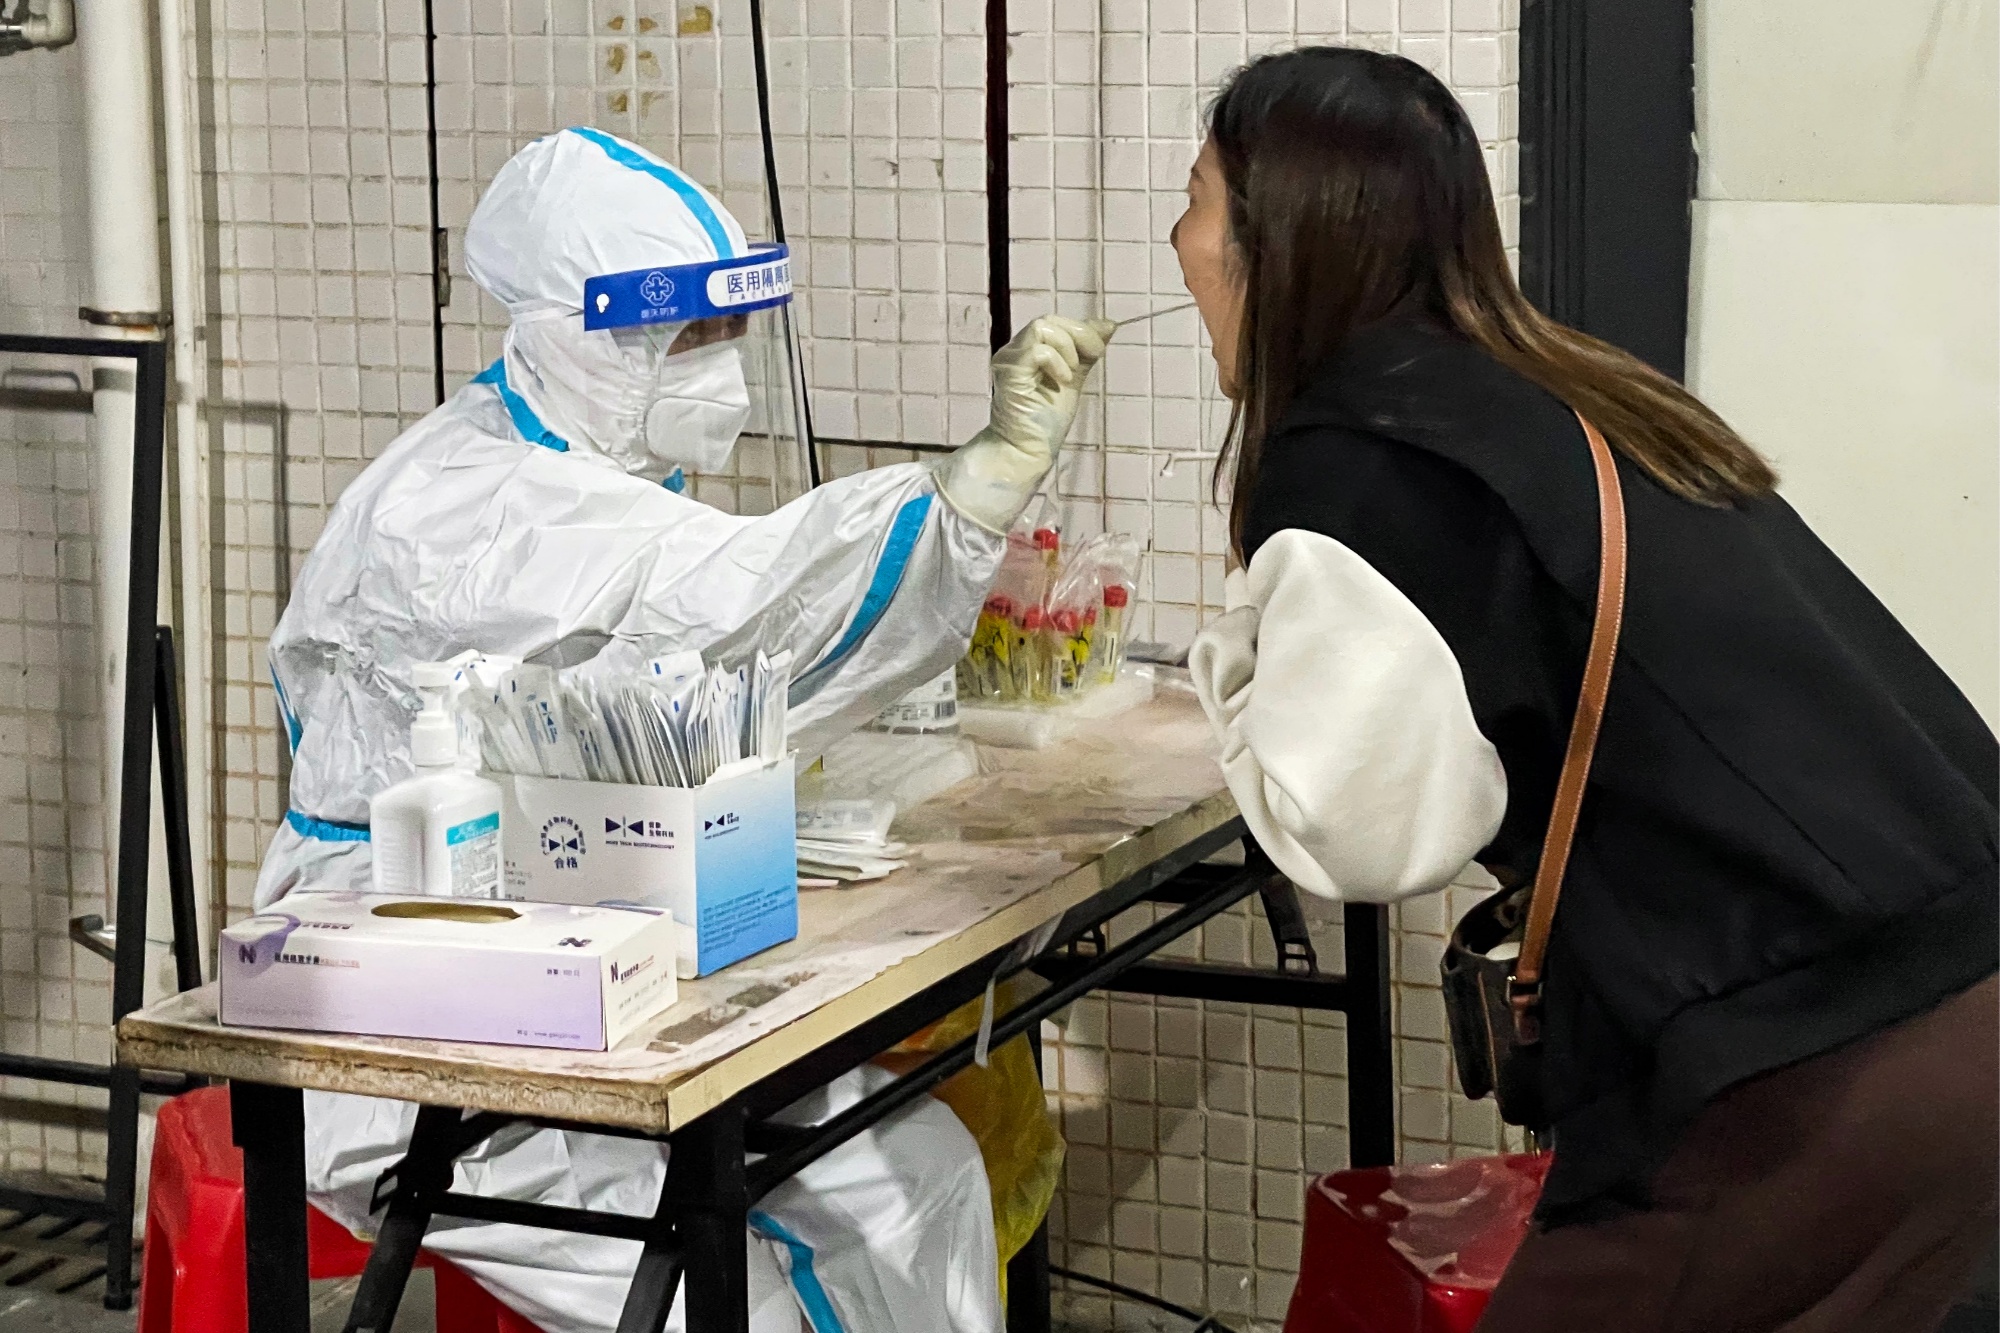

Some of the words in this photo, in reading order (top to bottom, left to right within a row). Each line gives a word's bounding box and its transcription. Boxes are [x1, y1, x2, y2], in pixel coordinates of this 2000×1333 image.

[554, 856, 578, 869] 合格
[240, 944, 256, 963] N
[611, 961, 619, 983] N
